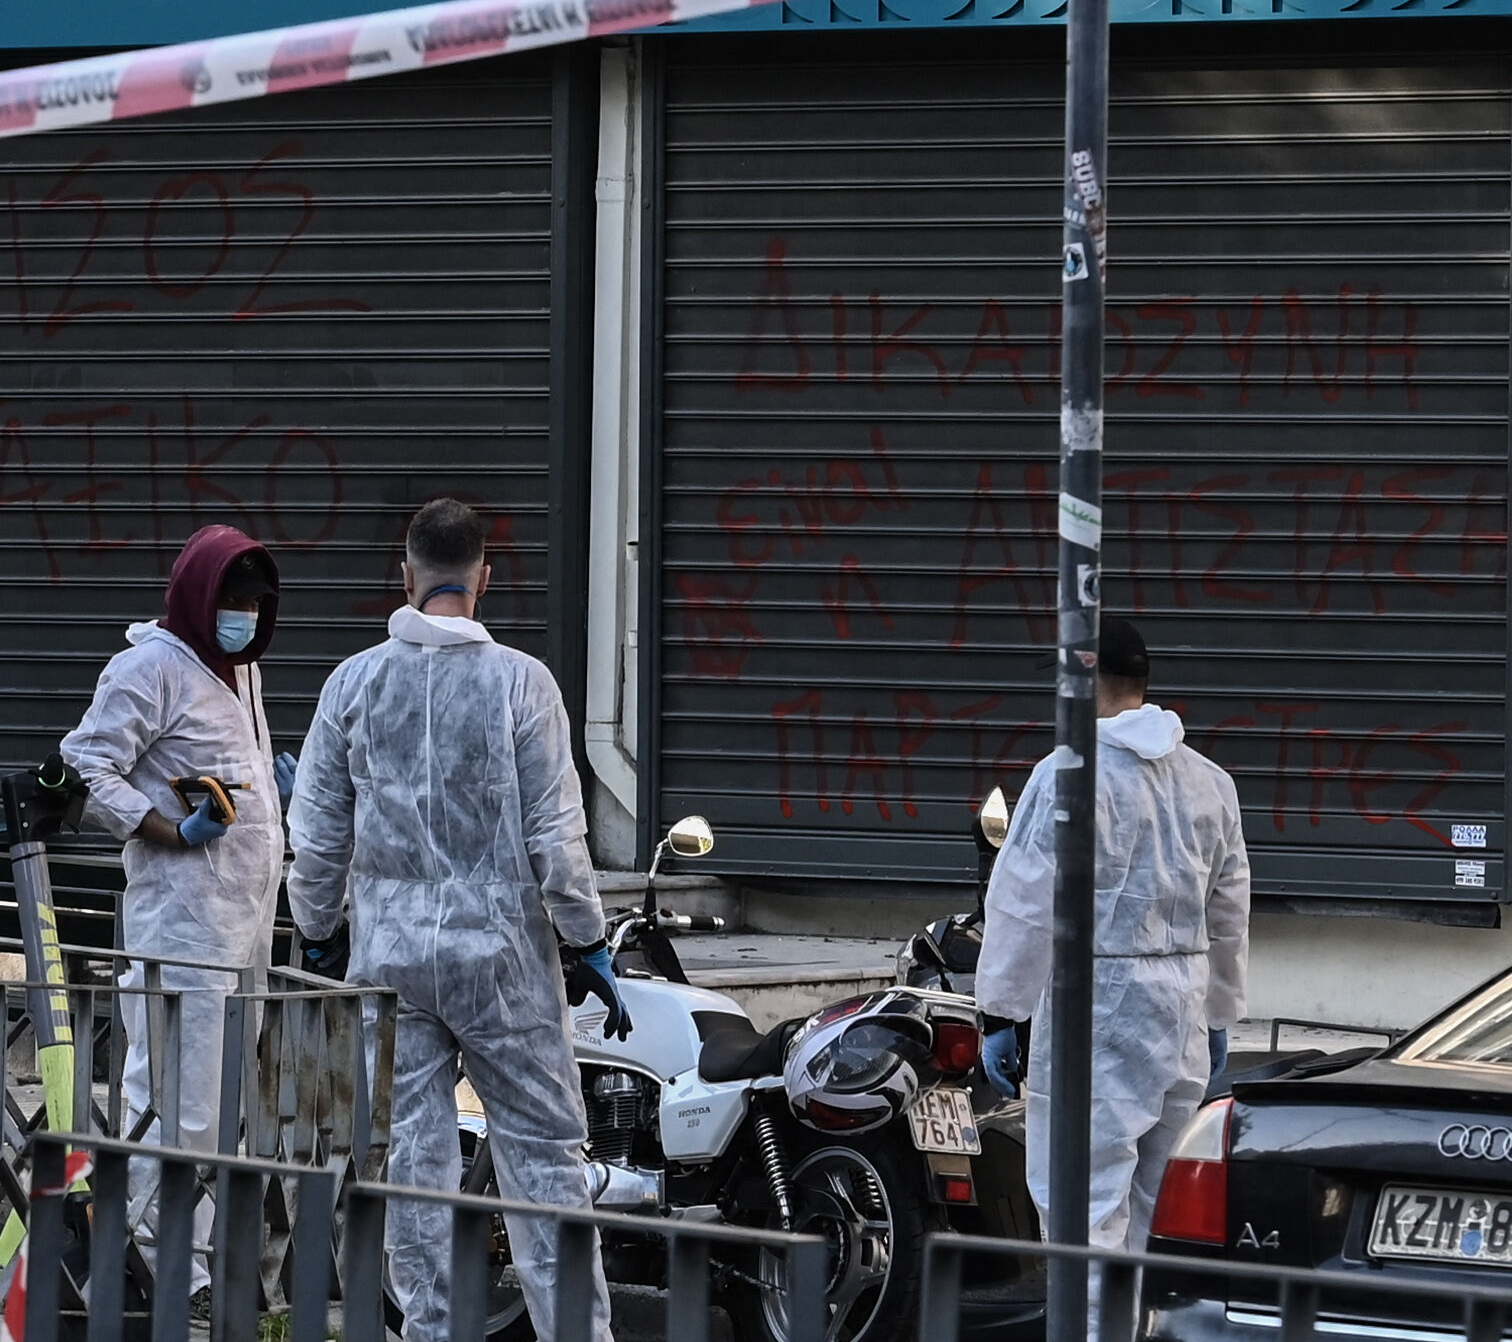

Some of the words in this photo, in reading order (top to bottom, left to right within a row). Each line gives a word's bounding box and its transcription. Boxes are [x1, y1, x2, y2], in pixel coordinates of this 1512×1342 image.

[678, 1106, 712, 1119] HONDA
[915, 1118, 959, 1148] 764
[1236, 1222, 1281, 1249] A4
[1380, 1193, 1464, 1250] KZM
